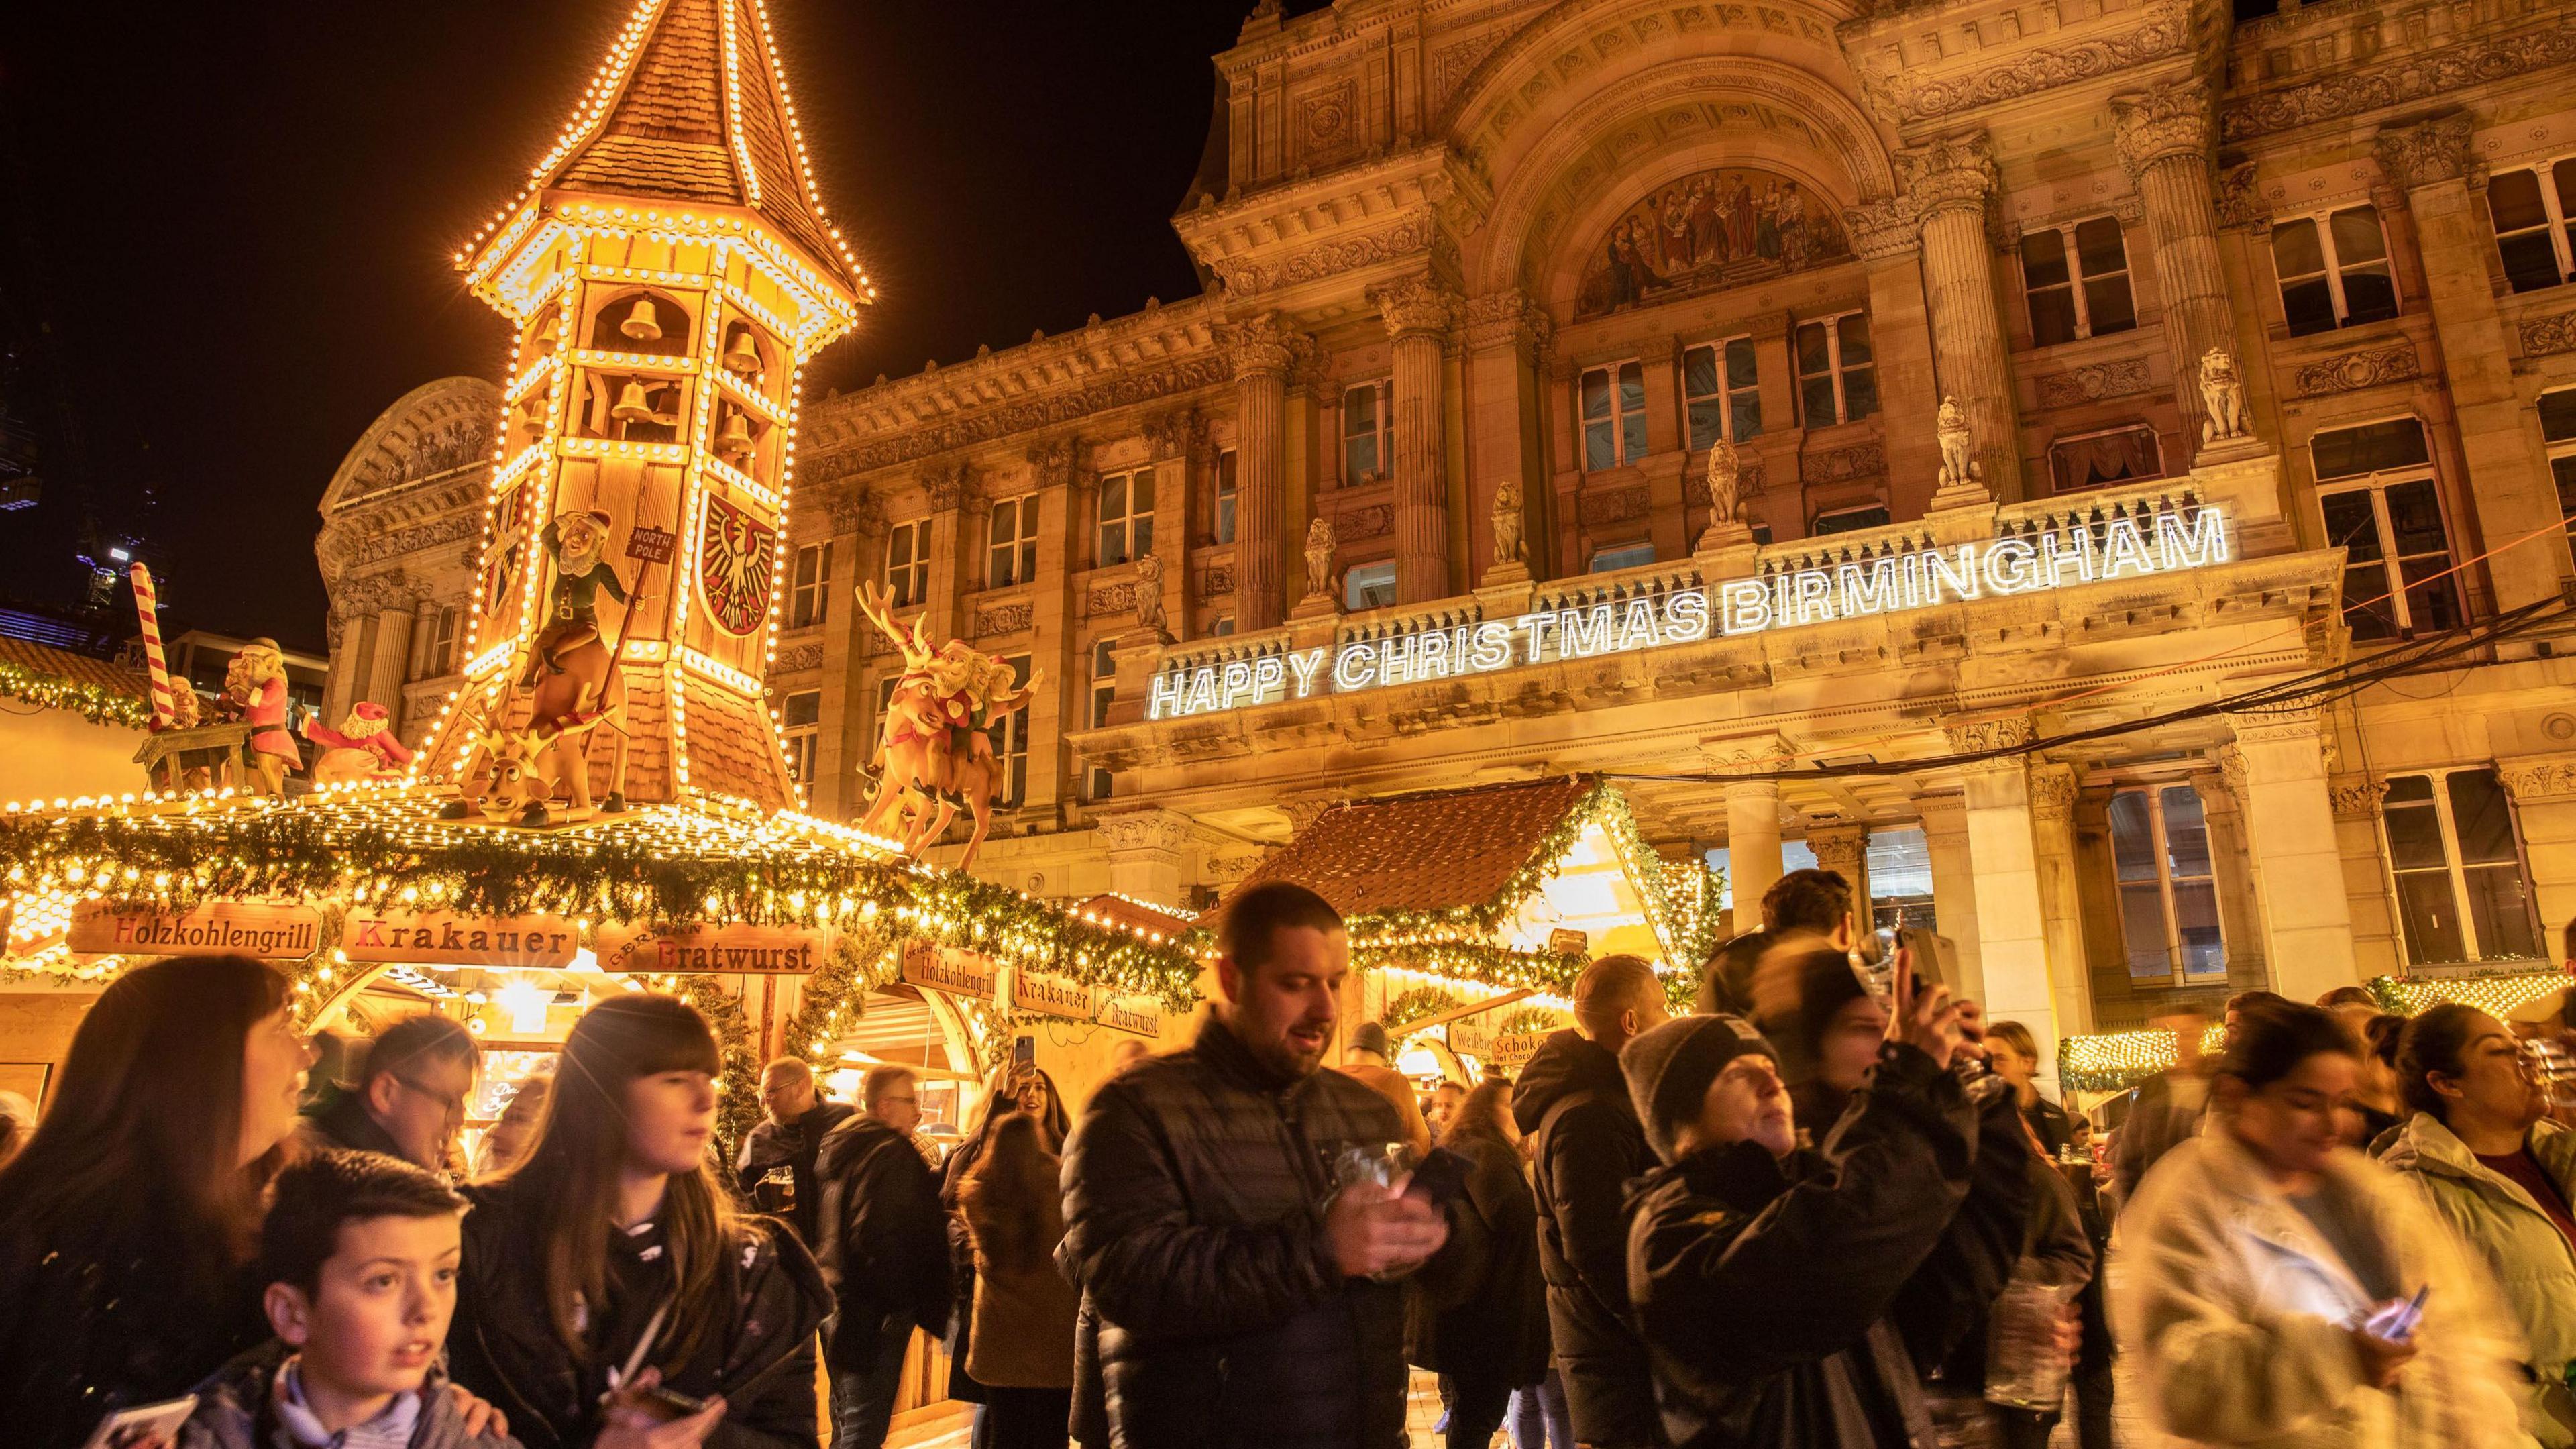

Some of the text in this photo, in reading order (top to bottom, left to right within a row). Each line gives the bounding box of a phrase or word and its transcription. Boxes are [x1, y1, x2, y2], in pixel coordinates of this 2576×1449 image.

[635, 530, 671, 547] NORTH
[636, 545, 662, 559] POLE
[1150, 508, 2228, 720] HAPPY CHRISTMAS BIRMINGHAM
[113, 917, 312, 953] Holzkohlengrill
[355, 920, 568, 954] Krakauer
[657, 941, 812, 969] Bratwurst
[921, 956, 995, 996] Holzkohlengrill
[1018, 974, 1087, 1010] Krakauer
[1096, 991, 1127, 1019] GERMAN
[1112, 1002, 1157, 1033] Bratwurst
[1494, 1054, 1507, 1062] Hot
